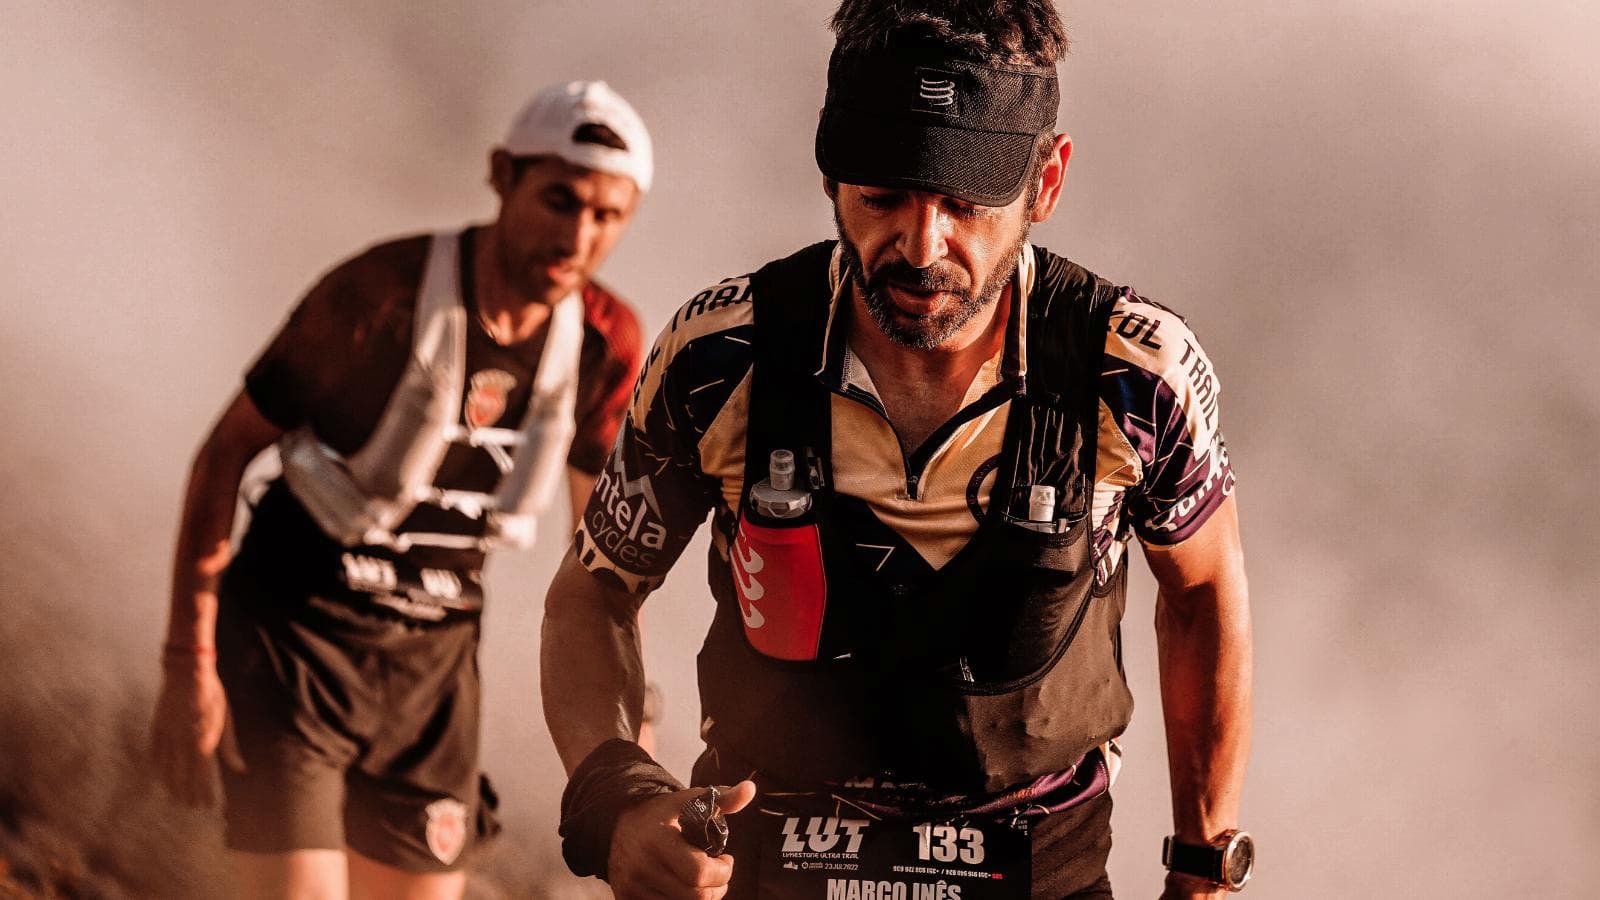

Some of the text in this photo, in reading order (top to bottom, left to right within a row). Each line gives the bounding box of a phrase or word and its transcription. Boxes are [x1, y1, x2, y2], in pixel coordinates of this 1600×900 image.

[1180, 338, 1217, 431] TRAIL
[595, 468, 667, 551] ntela
[593, 510, 656, 567] cycles
[781, 816, 870, 852] LUT
[912, 822, 984, 864] 133
[827, 879, 962, 900] MARCO INÊS
